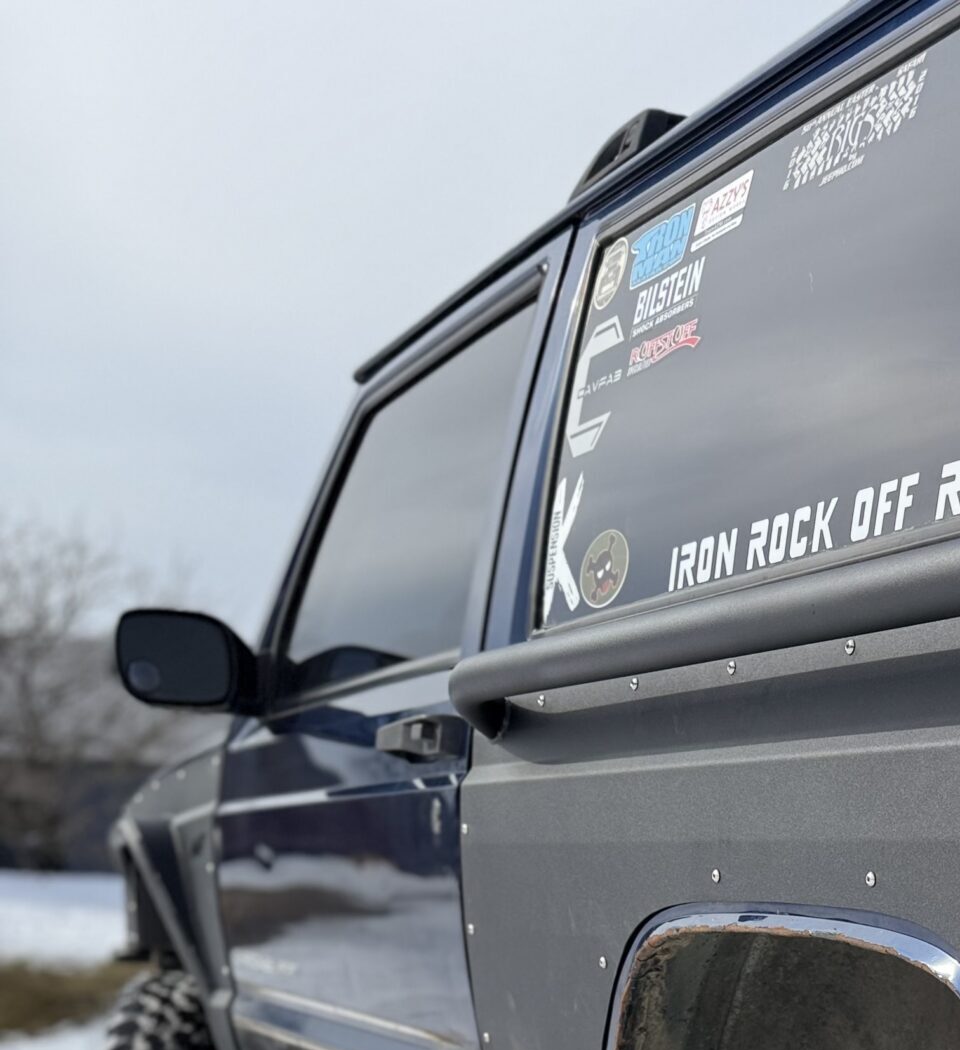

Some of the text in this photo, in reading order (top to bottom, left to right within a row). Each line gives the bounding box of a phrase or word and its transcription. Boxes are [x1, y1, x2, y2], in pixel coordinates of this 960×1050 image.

[631, 299, 694, 338] SHOCK ABSORBERS
[632, 256, 706, 326] BILSTEIN
[546, 510, 561, 591] SUSPENSION
[668, 528, 738, 592] IRON
[745, 497, 838, 571] ROCK
[850, 472, 920, 543] OFF
